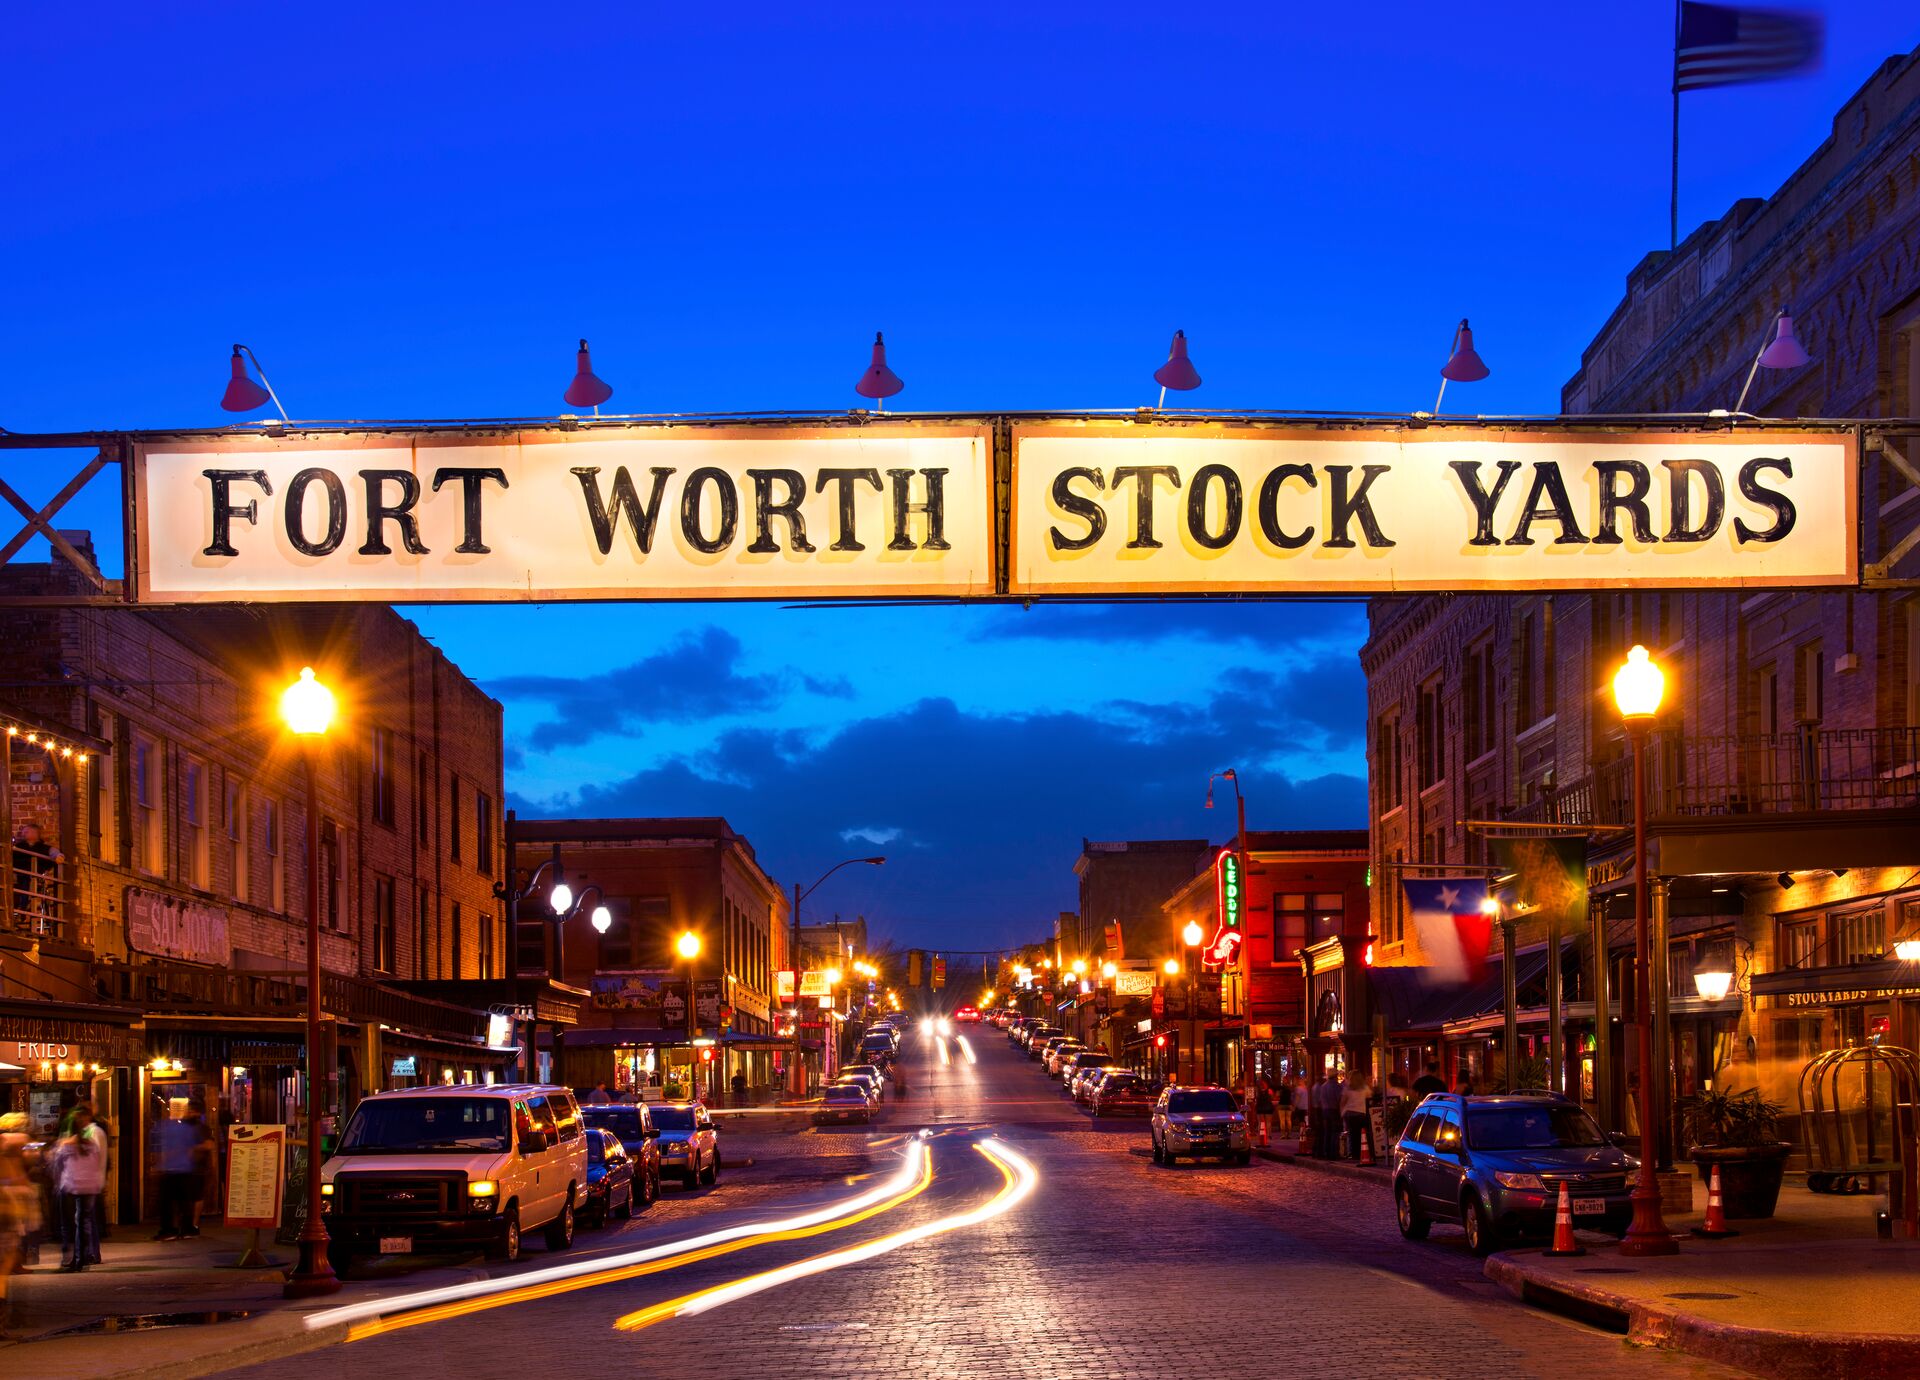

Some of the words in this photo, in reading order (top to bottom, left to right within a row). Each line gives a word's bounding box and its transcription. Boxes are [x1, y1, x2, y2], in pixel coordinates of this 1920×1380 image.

[202, 467, 510, 557] FORT
[570, 465, 952, 555] WORTH
[1049, 463, 1396, 551] STOCK
[1448, 457, 1798, 547] YARDS
[1126, 979, 1151, 991] RANCH
[1788, 990, 1867, 1006] STOCKYARDS
[74, 1022, 112, 1044] CASINO
